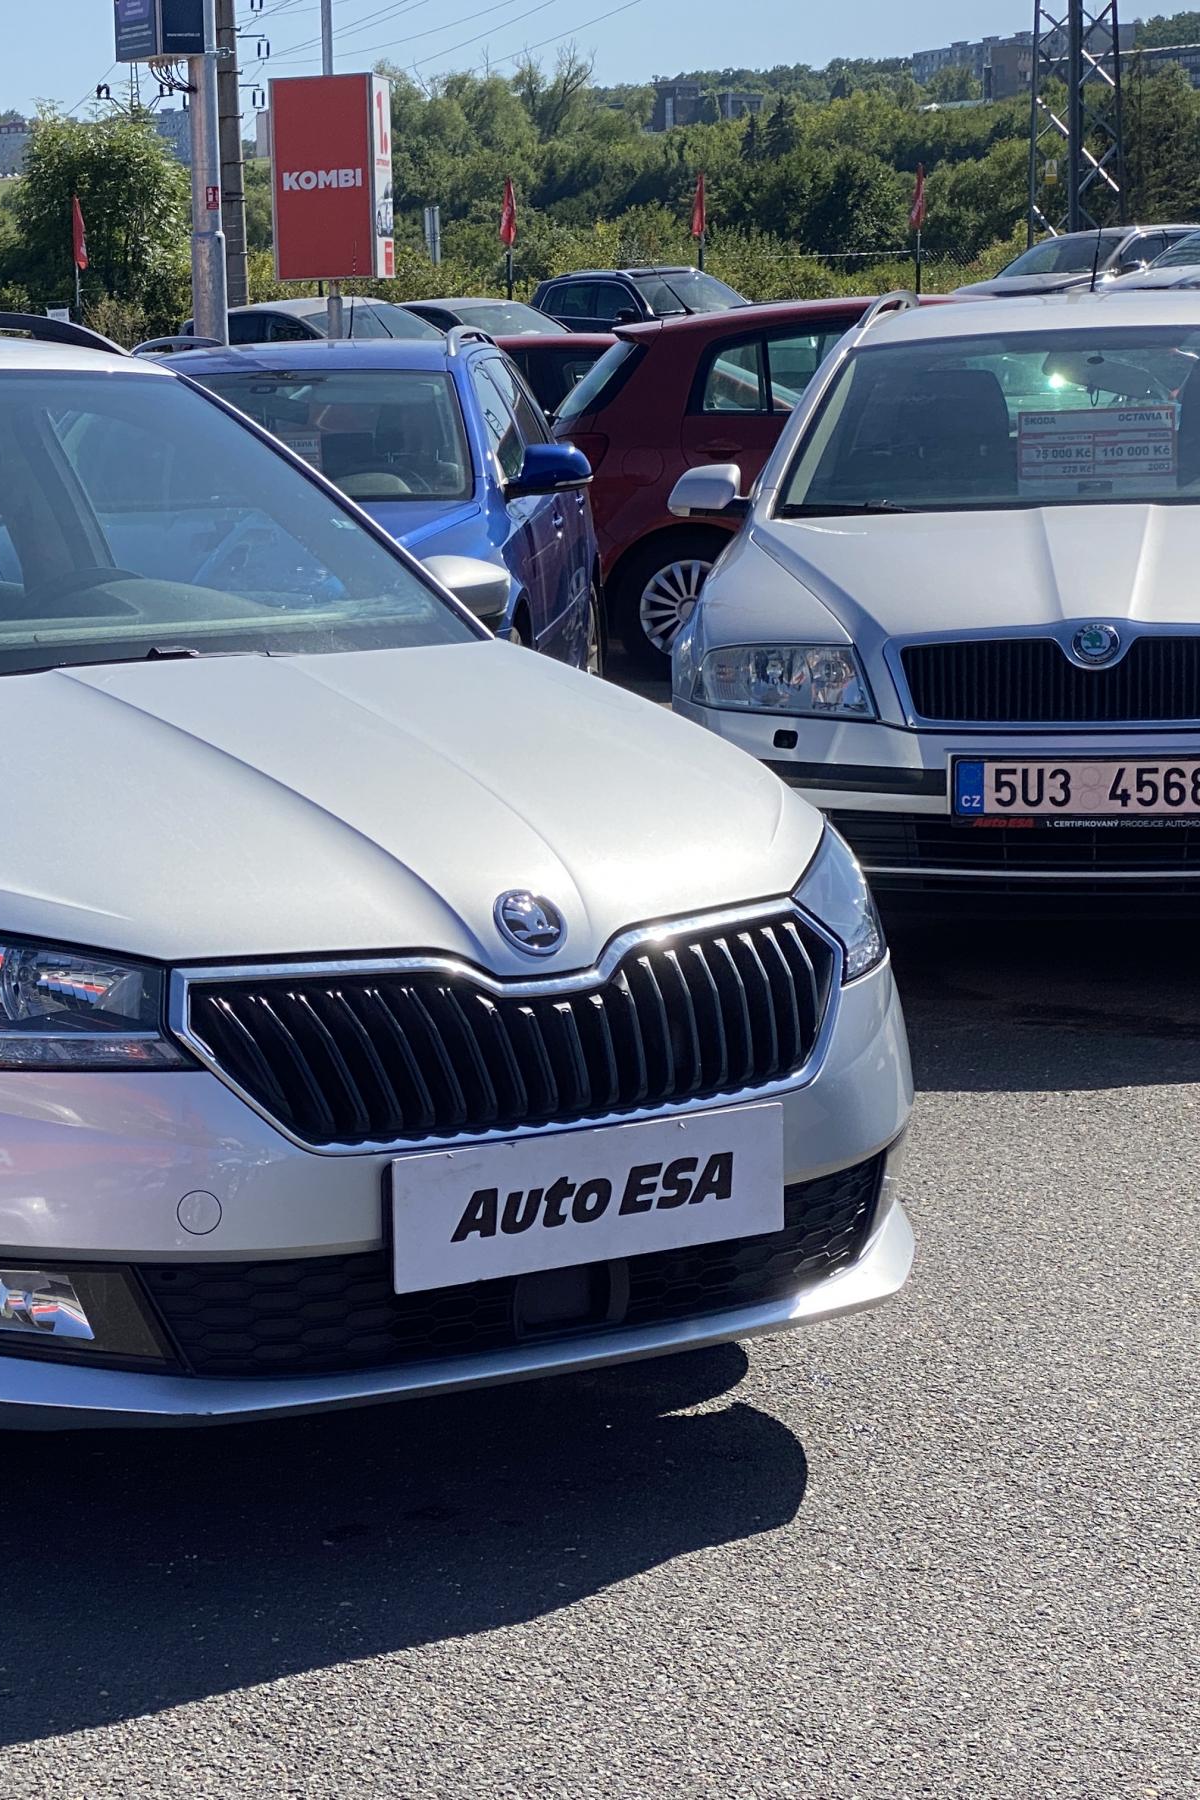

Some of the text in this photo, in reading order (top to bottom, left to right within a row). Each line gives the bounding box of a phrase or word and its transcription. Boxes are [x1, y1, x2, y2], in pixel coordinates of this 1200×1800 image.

[283, 168, 362, 191] KOMBI
[1118, 412, 1162, 421] OCTAVIA
[1103, 447, 1123, 457] 110
[1127, 446, 1149, 456] 000
[994, 768, 1072, 807] 5U3
[961, 795, 981, 808] CZ
[1053, 819, 1119, 828] CERTIFIKOVANÝ
[1120, 820, 1164, 828] PRODEJCE
[450, 1152, 734, 1242] Auto ESA
